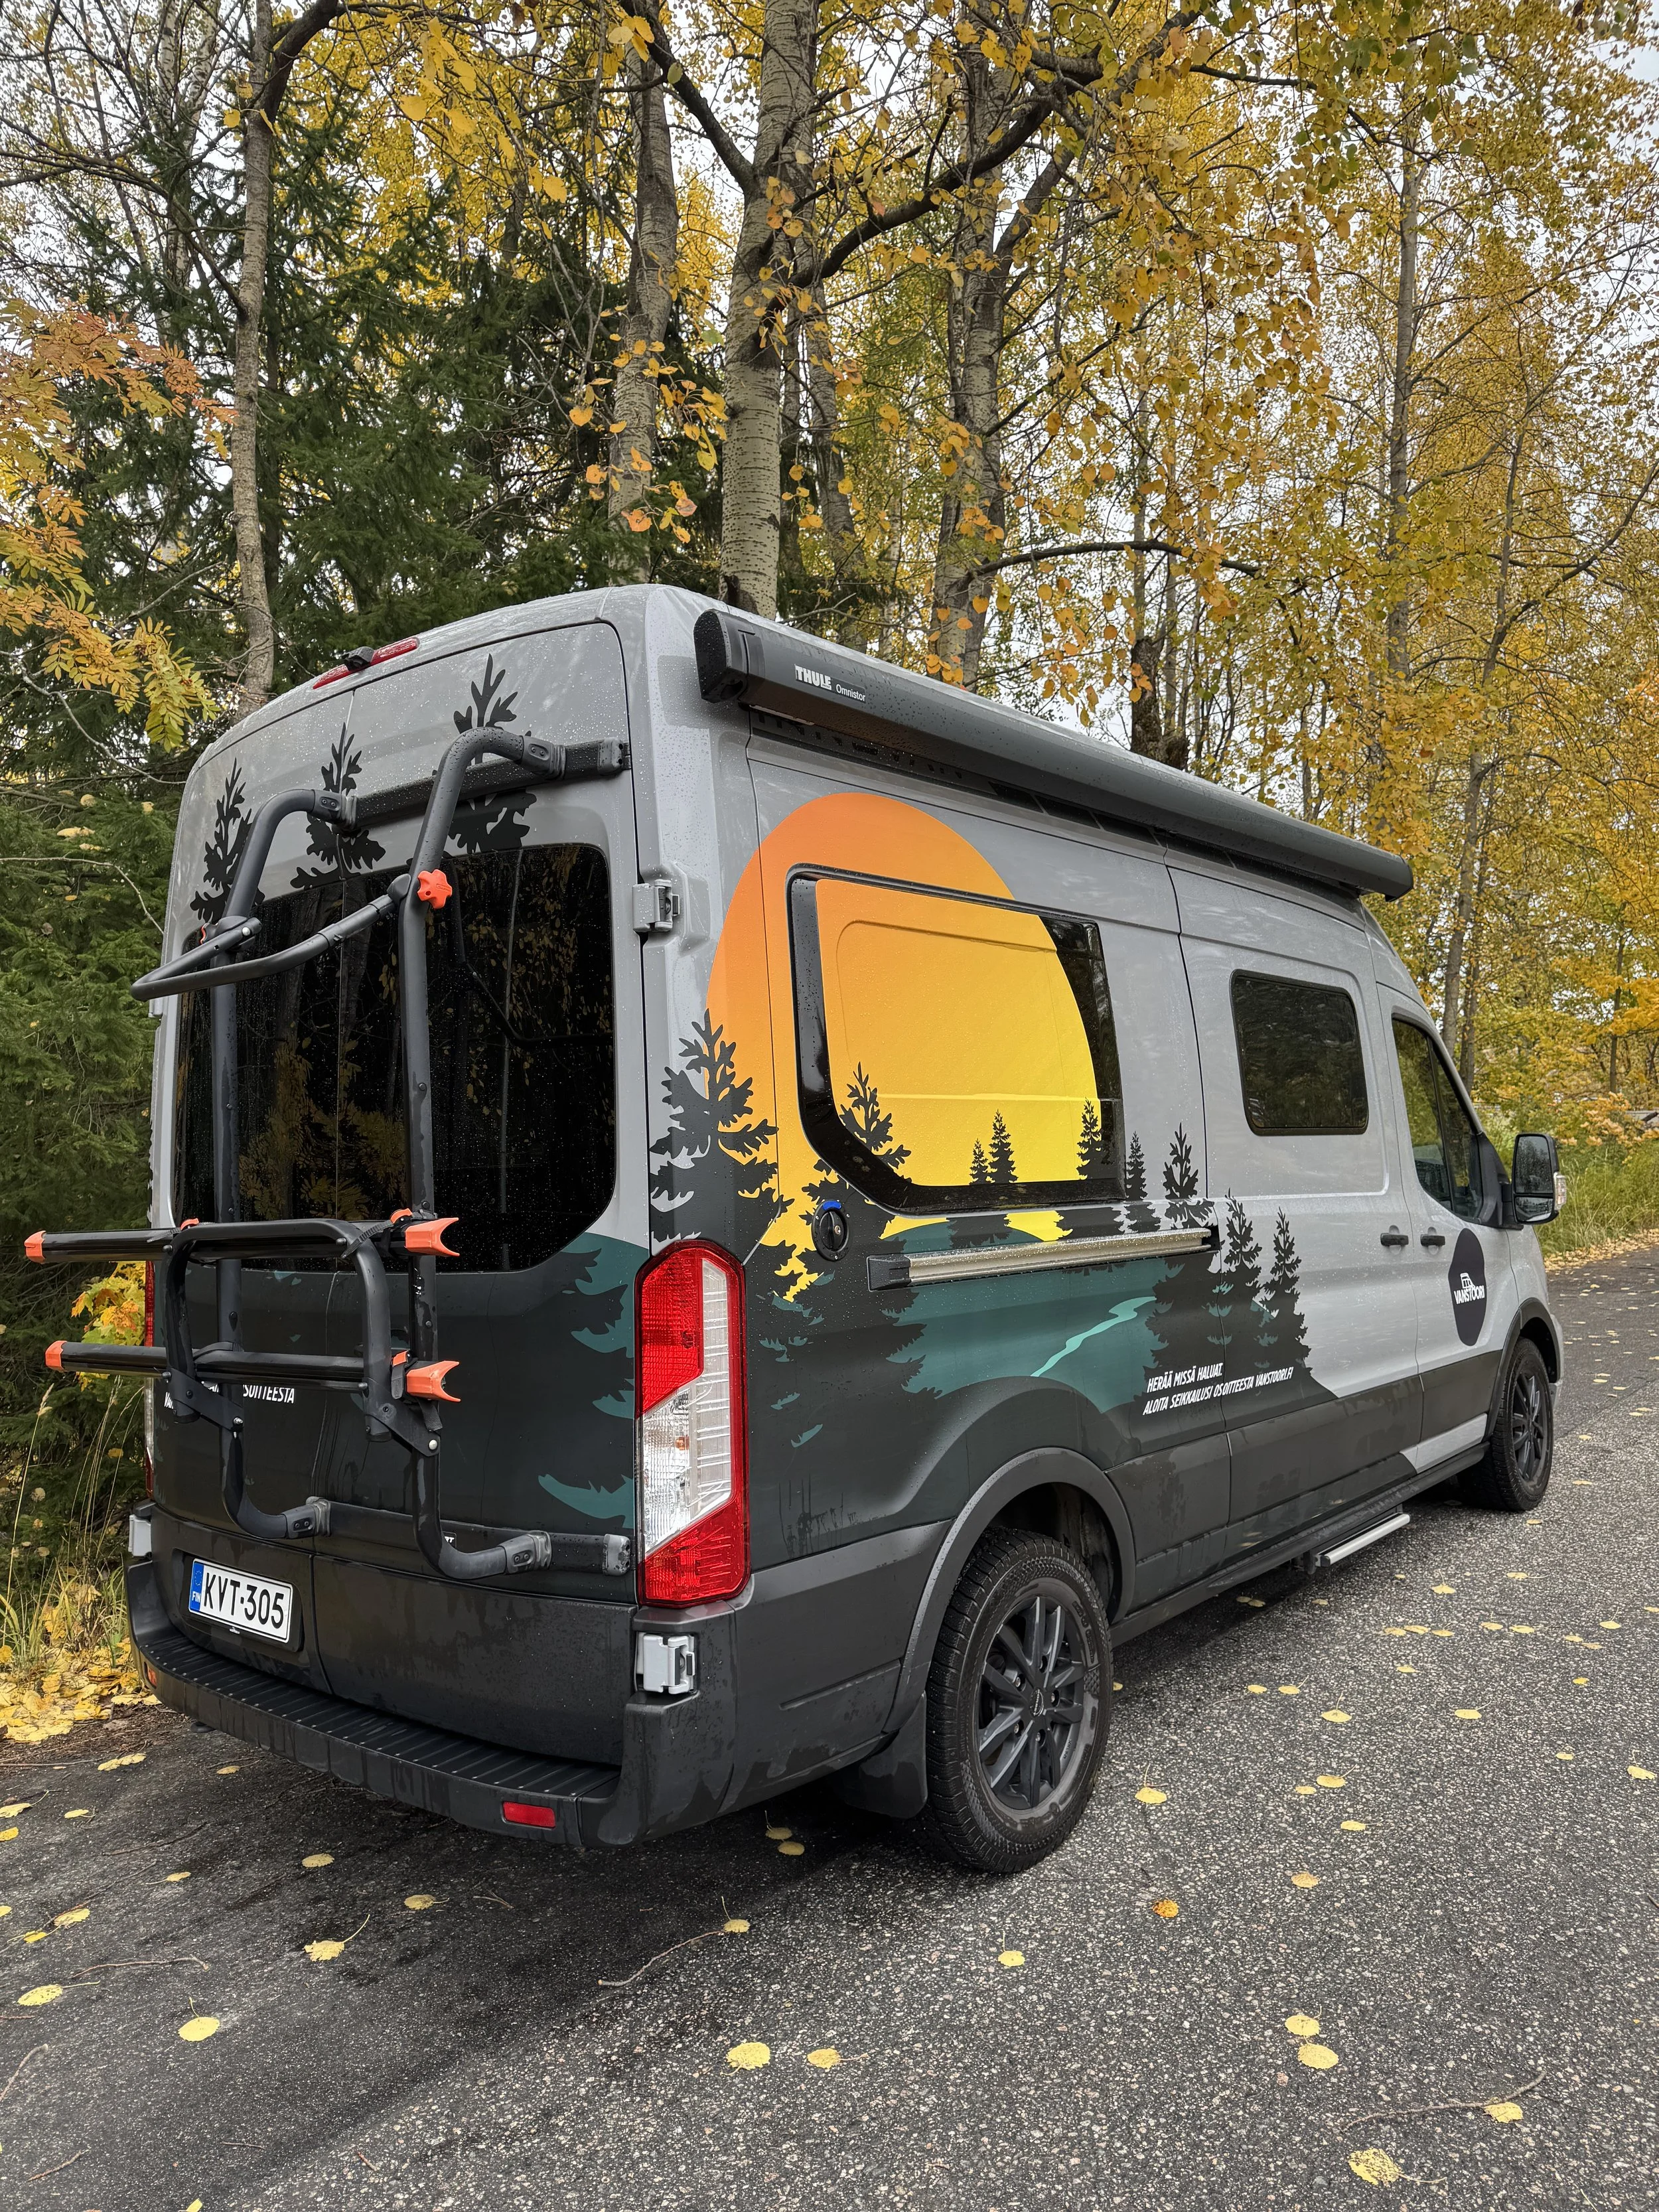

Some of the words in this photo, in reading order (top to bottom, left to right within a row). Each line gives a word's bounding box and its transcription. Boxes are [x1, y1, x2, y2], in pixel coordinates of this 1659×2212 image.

[794, 664, 832, 690] THULE
[836, 684, 866, 701] Omnistor
[1454, 1286, 1485, 1304] VANSTOORI
[1147, 1371, 1173, 1393] HERÄÄ
[1173, 1366, 1196, 1386] MISSÄ
[1197, 1363, 1224, 1381] HALUAT.
[1143, 1396, 1168, 1416] ALOITA
[1169, 1385, 1213, 1409] SEIKKAILUSI
[1213, 1376, 1254, 1398] OSOITTEESTA
[192, 1591, 201, 1603] FIN
[204, 1572, 284, 1629] KVT-305
